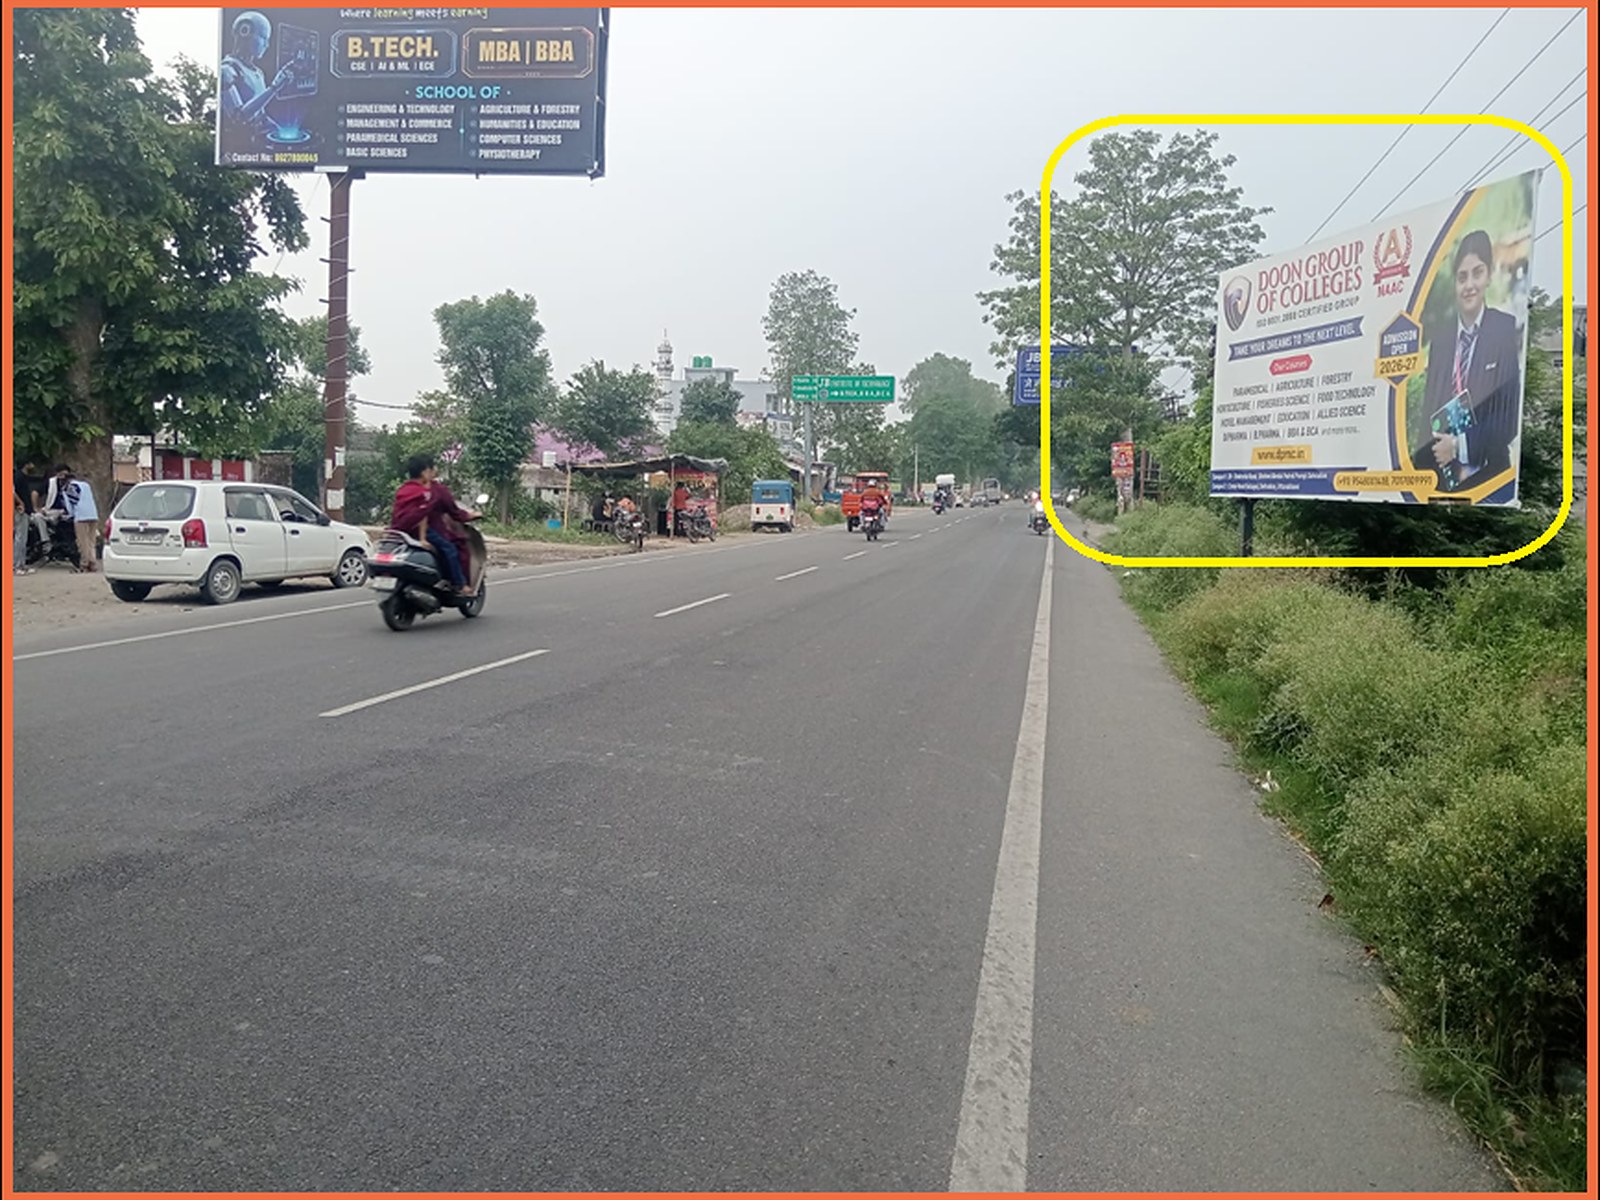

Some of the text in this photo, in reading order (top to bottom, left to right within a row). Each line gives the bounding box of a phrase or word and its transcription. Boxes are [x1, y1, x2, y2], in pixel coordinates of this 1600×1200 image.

[347, 36, 439, 58] B.TECH.
[479, 40, 575, 62] MBA BBA
[350, 61, 366, 71] CSE
[378, 61, 387, 71] AI
[397, 61, 410, 71] ML
[419, 61, 435, 71] ECE
[415, 85, 501, 99] SCHOOL OF
[346, 104, 455, 114] ENGINEERING & TECHNOLOGY
[480, 104, 580, 114] AGRICULTURE & FORESTRY
[346, 118, 453, 129] MANAGEMENT & COMMERCE
[479, 119, 580, 130] HUMANITIES & EDUCATION
[346, 132, 438, 143] PARAMEDICAL SCIENCES
[479, 134, 562, 144] COMPUTER SCIENCES
[345, 147, 407, 158] BASIC SCIENCES
[478, 149, 541, 159] PHYSIOTHERAPY
[1258, 240, 1365, 292] DOON GROUP
[1256, 266, 1363, 315] OF COLLEGES
[1377, 280, 1405, 298] NAAC
[1298, 302, 1333, 318] CERTIFIED
[1266, 337, 1293, 352] DREAMS
[1293, 335, 1302, 346] TO
[1303, 331, 1316, 344] THE
[1316, 327, 1334, 341] NEXT
[1383, 329, 1418, 345] ADMISSION
[1391, 343, 1408, 355] OPEN
[1380, 356, 1418, 374] 2026-27
[1276, 376, 1314, 392] AGRICULTURE
[1321, 371, 1353, 386] FORESTRY
[1317, 390, 1334, 403] FOOD
[1334, 385, 1376, 401] TECHNOLOGY
[1277, 410, 1311, 424] EDUCATION
[1339, 404, 1367, 418] SCIENCE
